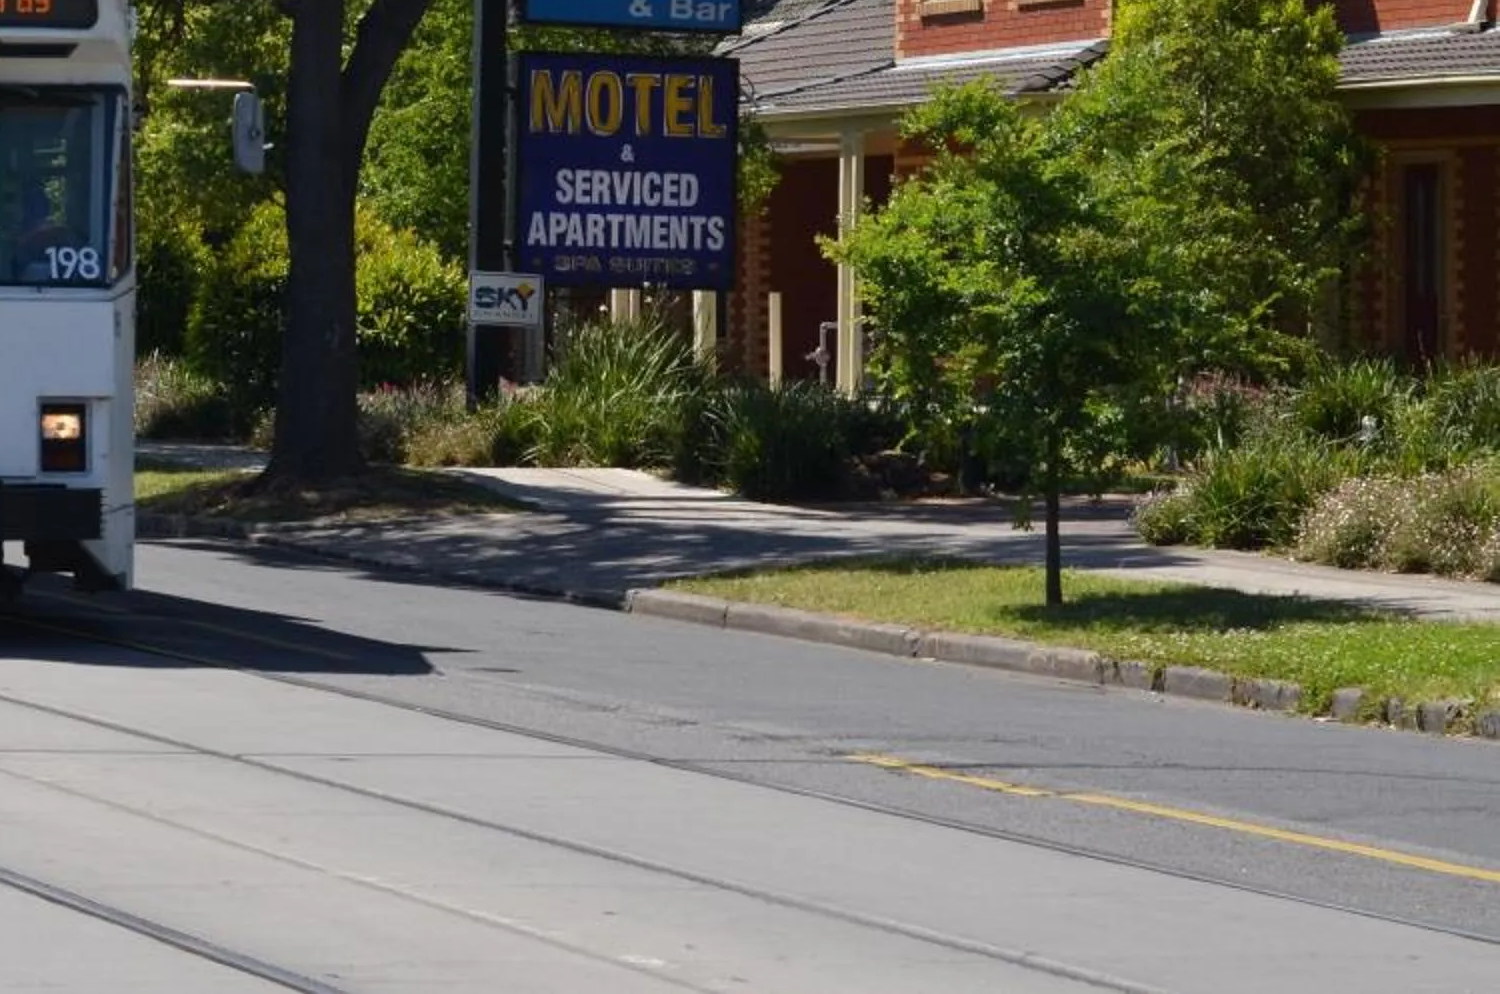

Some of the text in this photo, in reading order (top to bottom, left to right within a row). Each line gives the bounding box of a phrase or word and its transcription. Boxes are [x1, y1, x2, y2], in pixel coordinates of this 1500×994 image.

[529, 69, 728, 140] MOTEL
[620, 144, 635, 163] &
[555, 169, 700, 207] SERVICED
[527, 211, 726, 252] APARTMENTS
[45, 246, 100, 279] 198
[474, 282, 536, 311] SKY
